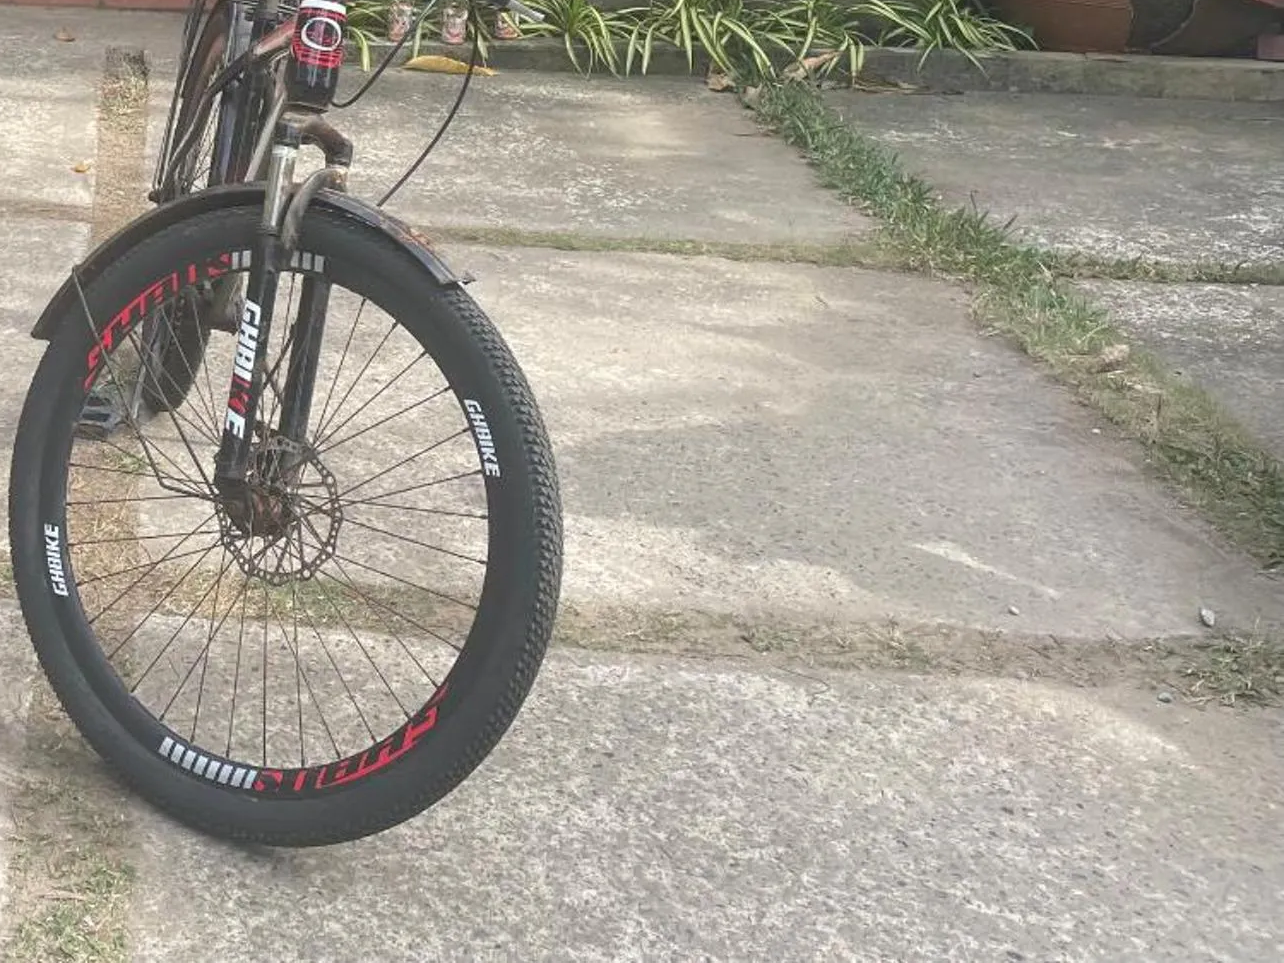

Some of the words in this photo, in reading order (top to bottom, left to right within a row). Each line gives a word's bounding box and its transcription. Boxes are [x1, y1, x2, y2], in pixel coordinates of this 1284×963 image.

[225, 298, 262, 440] GHBIKE
[462, 398, 501, 478] GHBIKE
[43, 523, 70, 597] GHBIKE
